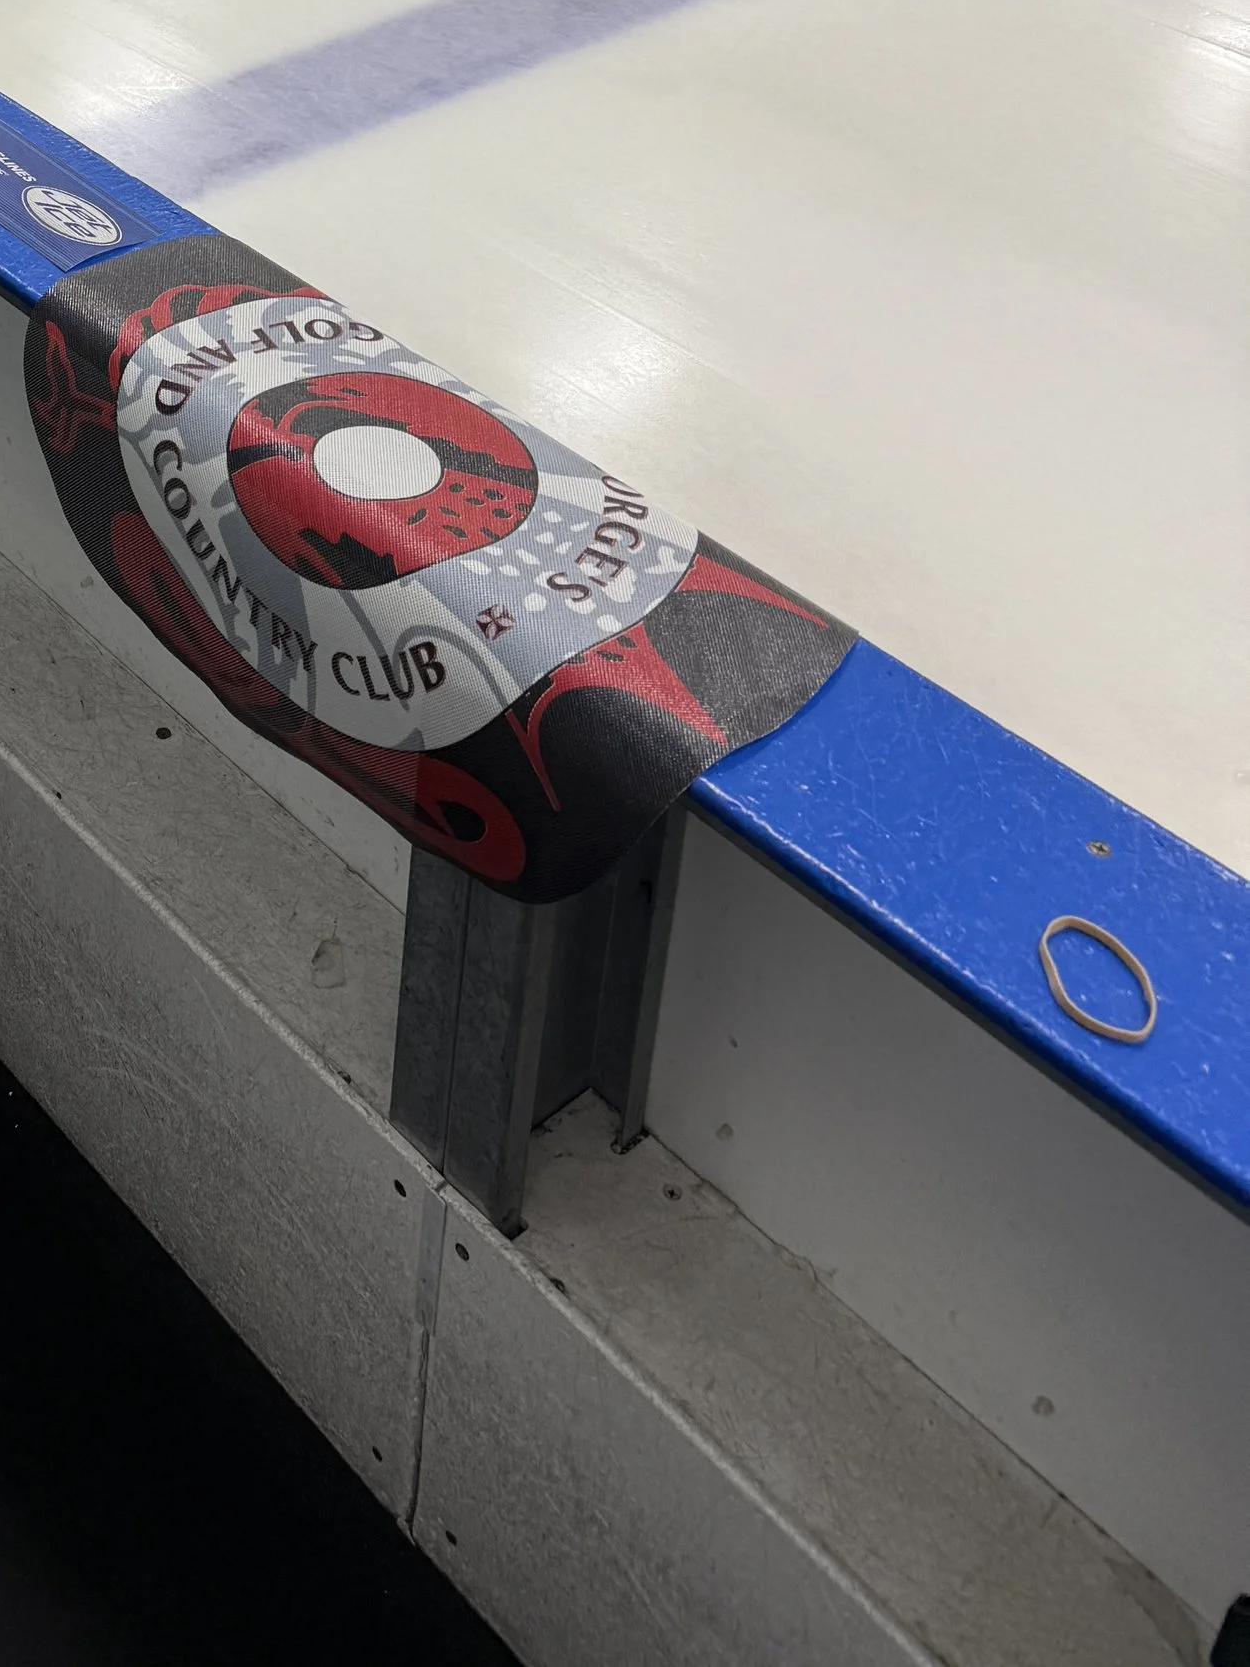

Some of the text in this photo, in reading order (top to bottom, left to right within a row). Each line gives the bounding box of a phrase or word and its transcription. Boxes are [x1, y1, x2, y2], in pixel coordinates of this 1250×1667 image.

[251, 318, 386, 355] GOLF
[155, 339, 238, 416] AND
[153, 438, 318, 674] COUNTRY
[331, 640, 447, 702] CLUB
